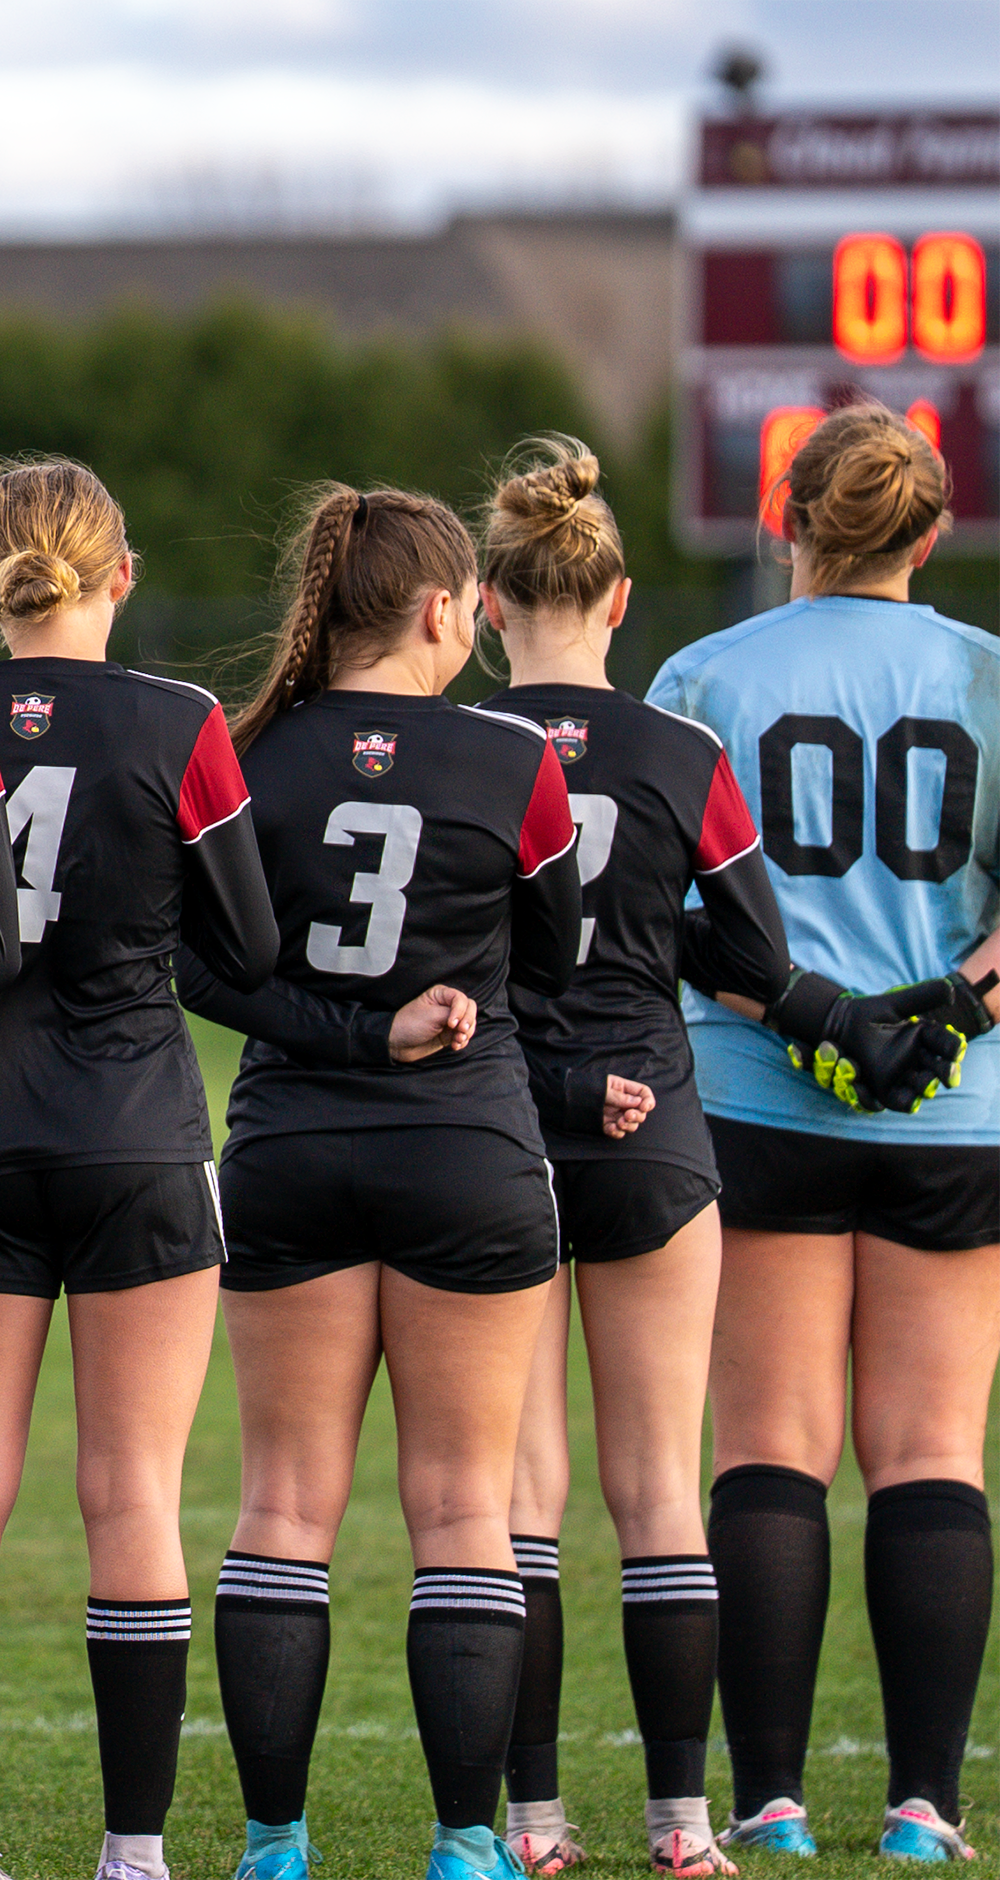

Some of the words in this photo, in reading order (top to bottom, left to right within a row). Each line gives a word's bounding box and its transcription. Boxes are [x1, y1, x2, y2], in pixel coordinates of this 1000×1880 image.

[833, 231, 986, 366] 00
[12, 704, 23, 714] DE
[26, 704, 51, 714] PERE
[368, 742, 394, 752] PERE
[5, 765, 77, 943] 4
[758, 712, 979, 883] 00
[306, 801, 423, 976] 3
